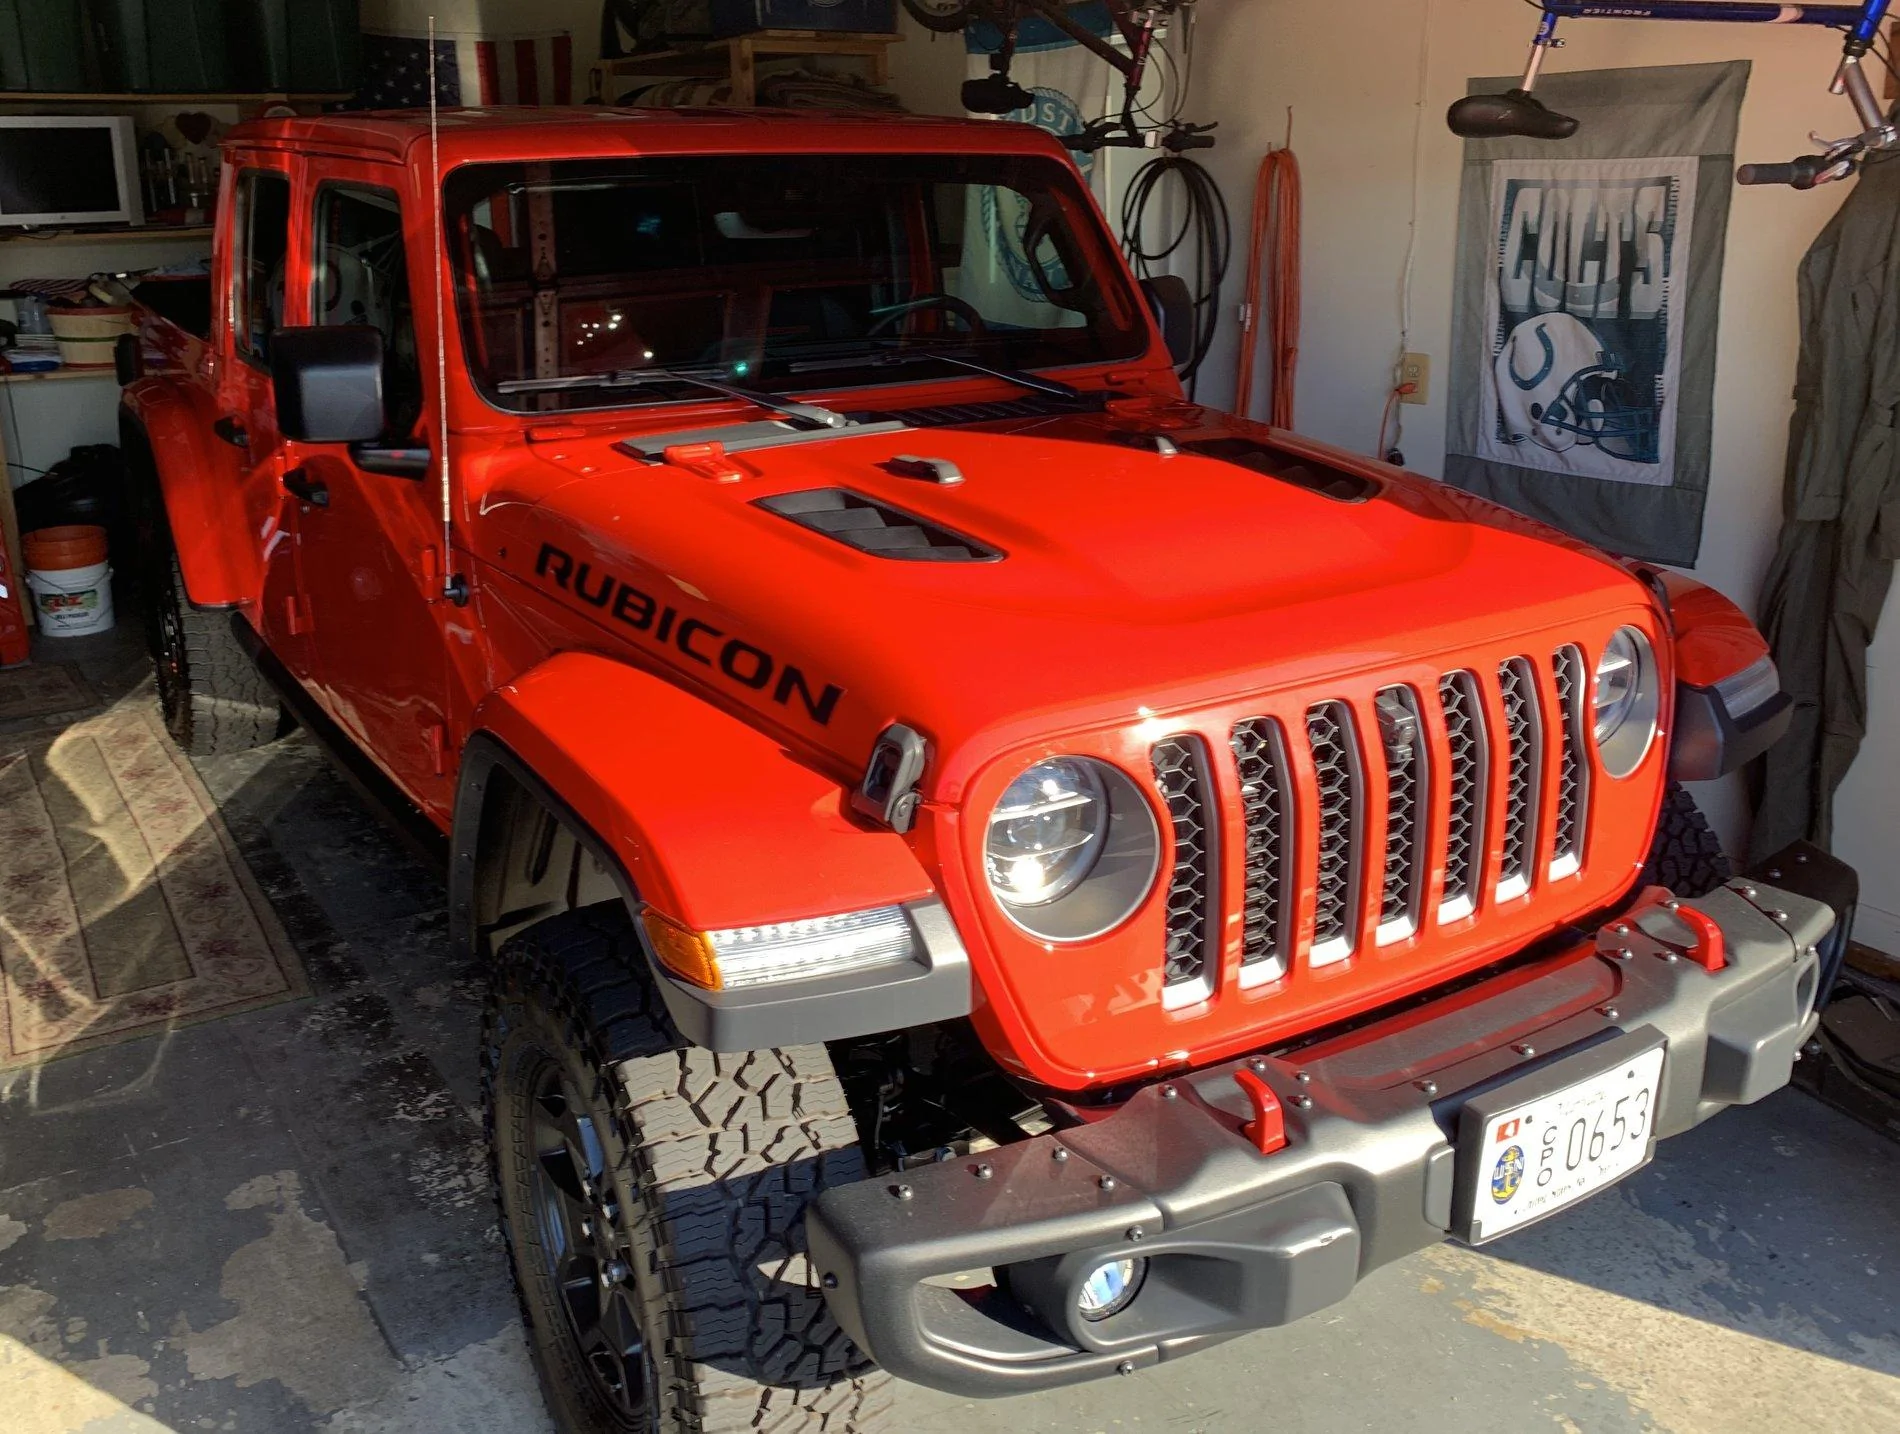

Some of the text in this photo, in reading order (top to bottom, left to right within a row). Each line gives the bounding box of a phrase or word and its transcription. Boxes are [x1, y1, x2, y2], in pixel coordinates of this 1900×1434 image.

[1582, 8, 1652, 16] FRONTIER
[1501, 186, 1666, 319] COLTS
[535, 542, 846, 726] RUBICON
[1537, 1125, 1558, 1187] CPO
[1565, 1087, 1650, 1171] 0653
